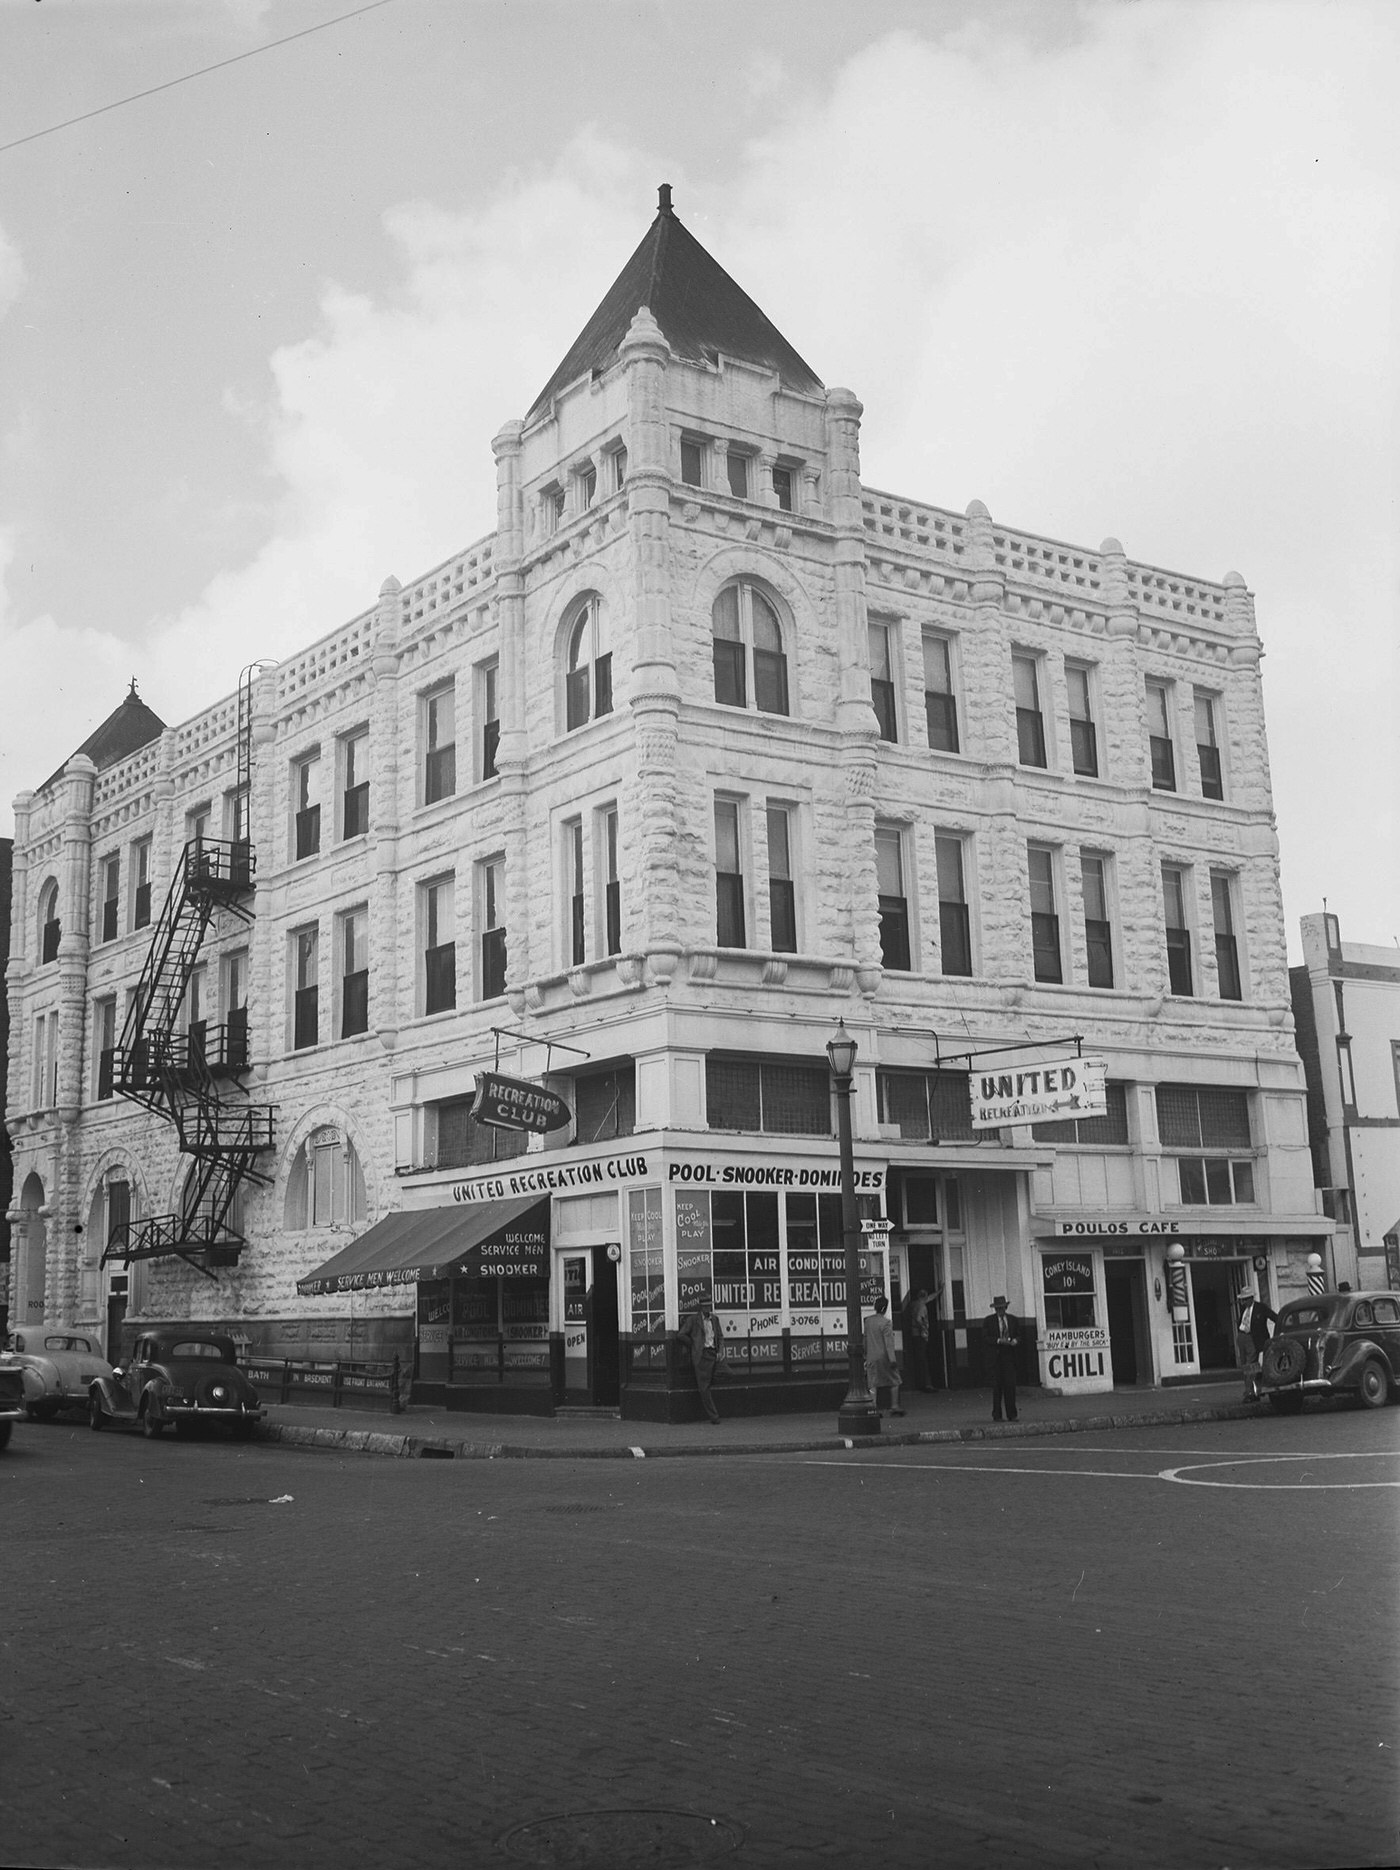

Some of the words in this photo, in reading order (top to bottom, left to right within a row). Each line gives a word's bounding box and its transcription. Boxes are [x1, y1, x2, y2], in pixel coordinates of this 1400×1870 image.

[980, 1066, 1076, 1100] UNITED
[489, 1083, 560, 1114] RECREATION
[497, 1103, 547, 1127] CLUB
[980, 1103, 1053, 1120] RECREATION
[453, 1180, 504, 1202] UNITED
[509, 1163, 603, 1194] RECREATION
[606, 1156, 648, 1179] CLUB
[799, 1169, 883, 1188] DOMIOES
[677, 1203, 694, 1211] KEEP
[631, 1211, 645, 1222] KEEP
[646, 1210, 662, 1221] COOL
[677, 1209, 701, 1227] COOL
[681, 1230, 704, 1238] PLAY
[1062, 1222, 1128, 1234] POULOS
[1139, 1222, 1179, 1233] CAFE
[505, 1232, 546, 1244] WELCOME
[637, 1232, 655, 1242] PLAY
[480, 1244, 520, 1256] SERVICE
[524, 1244, 544, 1255] MEN
[480, 1263, 538, 1276] SNOOKER
[678, 1254, 710, 1270] SNOOKER
[753, 1257, 777, 1271] AIR
[788, 1257, 867, 1271] CONDITIOD
[1044, 1262, 1065, 1278] CONEY
[1066, 1260, 1091, 1277] ISLAND
[337, 1273, 363, 1288] SERVICE
[366, 1271, 384, 1286] MEN
[386, 1268, 421, 1283] WELCOME
[681, 1282, 705, 1297] POOL
[714, 1283, 755, 1303] UNITED
[632, 1290, 647, 1306] POOL
[567, 1304, 583, 1315] AIR
[750, 1315, 780, 1332] PHONE
[567, 1332, 586, 1348] OPEN
[1049, 1330, 1105, 1341] HAMBURGERS
[790, 1341, 821, 1361] SERVICE
[826, 1340, 848, 1353] MEN
[1049, 1352, 1104, 1379] CHILI
[248, 1370, 270, 1380] BATH
[293, 1373, 300, 1381] IN
[304, 1373, 332, 1384] BASEMENT
